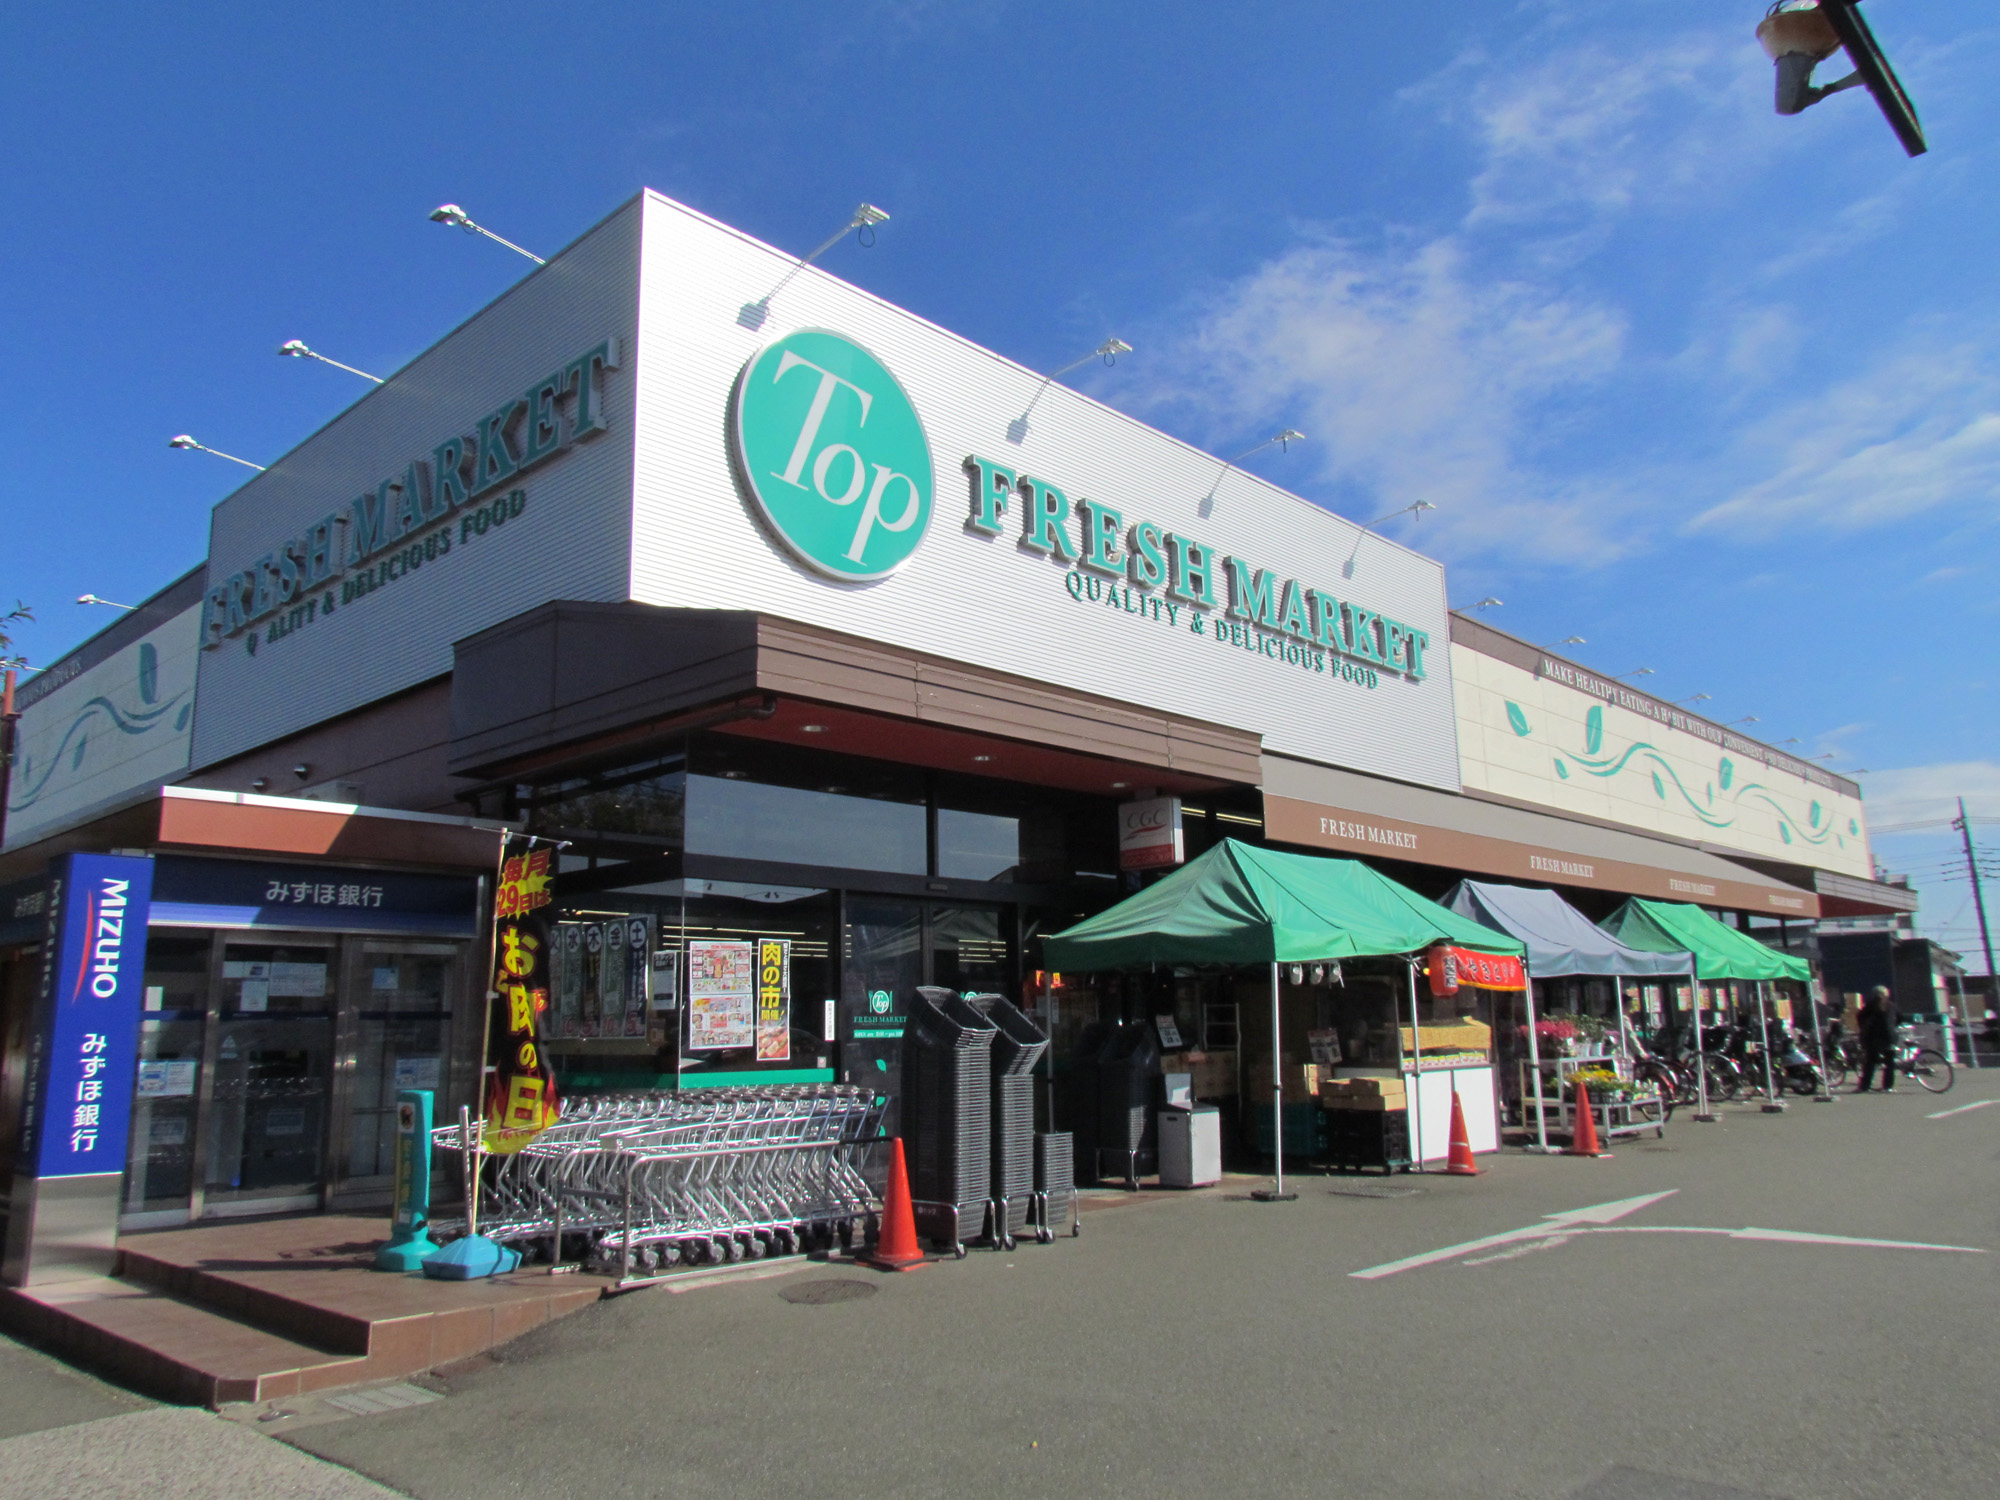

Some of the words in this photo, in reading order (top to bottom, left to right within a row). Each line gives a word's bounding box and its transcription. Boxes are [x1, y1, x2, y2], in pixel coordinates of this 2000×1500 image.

[200, 512, 347, 651] FRESH
[347, 337, 618, 568] MARKET
[770, 349, 920, 567] Top
[341, 527, 450, 605] DELICIOUS
[459, 489, 526, 544] FOOD
[966, 455, 1220, 611] FRESH
[1222, 554, 1430, 682] MARKET
[1066, 571, 1180, 626] QUALITY
[1191, 612, 1205, 635] &
[1215, 618, 1325, 673] DELICIOUS
[1331, 656, 1378, 690] FOOD
[1544, 659, 1573, 685] MAKE
[1575, 671, 1618, 703] HEALTHY
[1620, 690, 1652, 716] EATING
[1653, 705, 1660, 719] A
[1685, 718, 1706, 739] WITH
[504, 849, 551, 886] 毎月
[1320, 817, 1365, 840] FRESH
[1367, 826, 1418, 849] MARKET
[1530, 855, 1560, 873] FRESH
[1561, 861, 1594, 878] MARKET
[92, 877, 130, 999] MIZUHO
[265, 880, 384, 907] みずほ銀行
[497, 884, 552, 918] 29日は
[760, 942, 781, 1009] 肉の市
[72, 1033, 106, 1152] みずほ銀行
